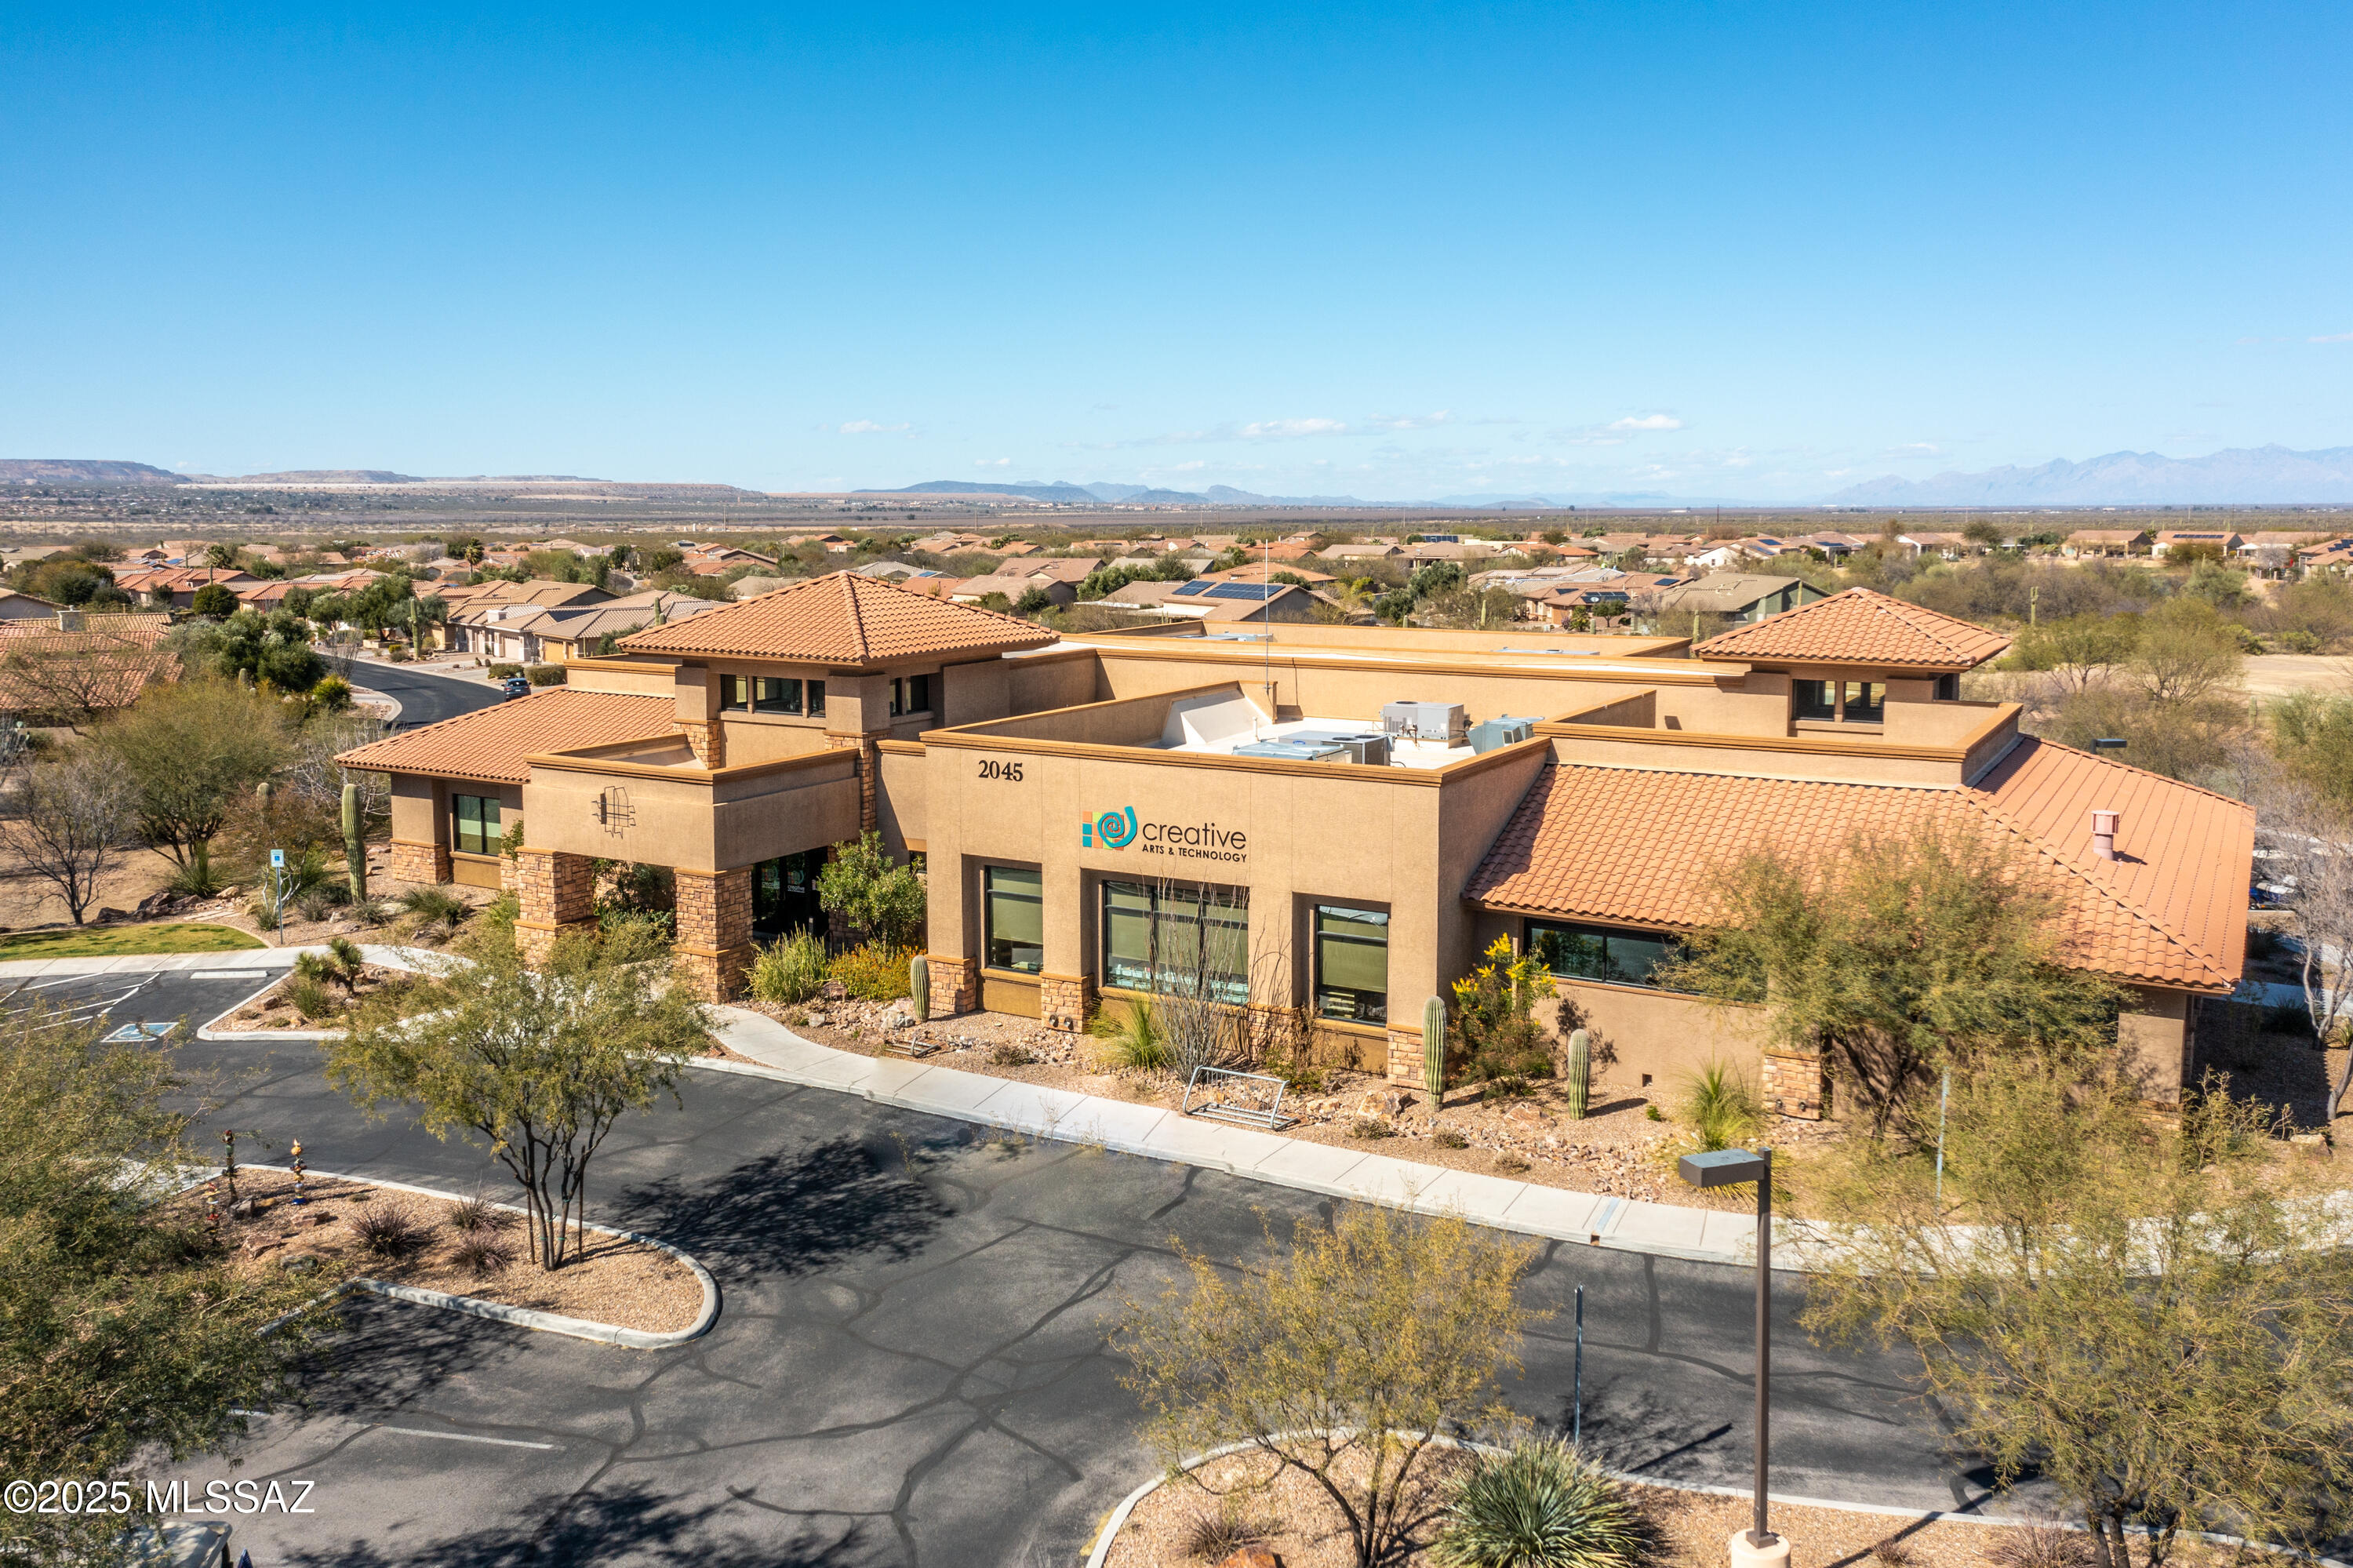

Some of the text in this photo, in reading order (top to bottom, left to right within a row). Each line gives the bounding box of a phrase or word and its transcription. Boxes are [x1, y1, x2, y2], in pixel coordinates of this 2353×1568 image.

[978, 759, 1024, 782] 2045
[1142, 822, 1247, 849] creative
[1142, 843, 1247, 863] ARTS & TECHNOLOGY
